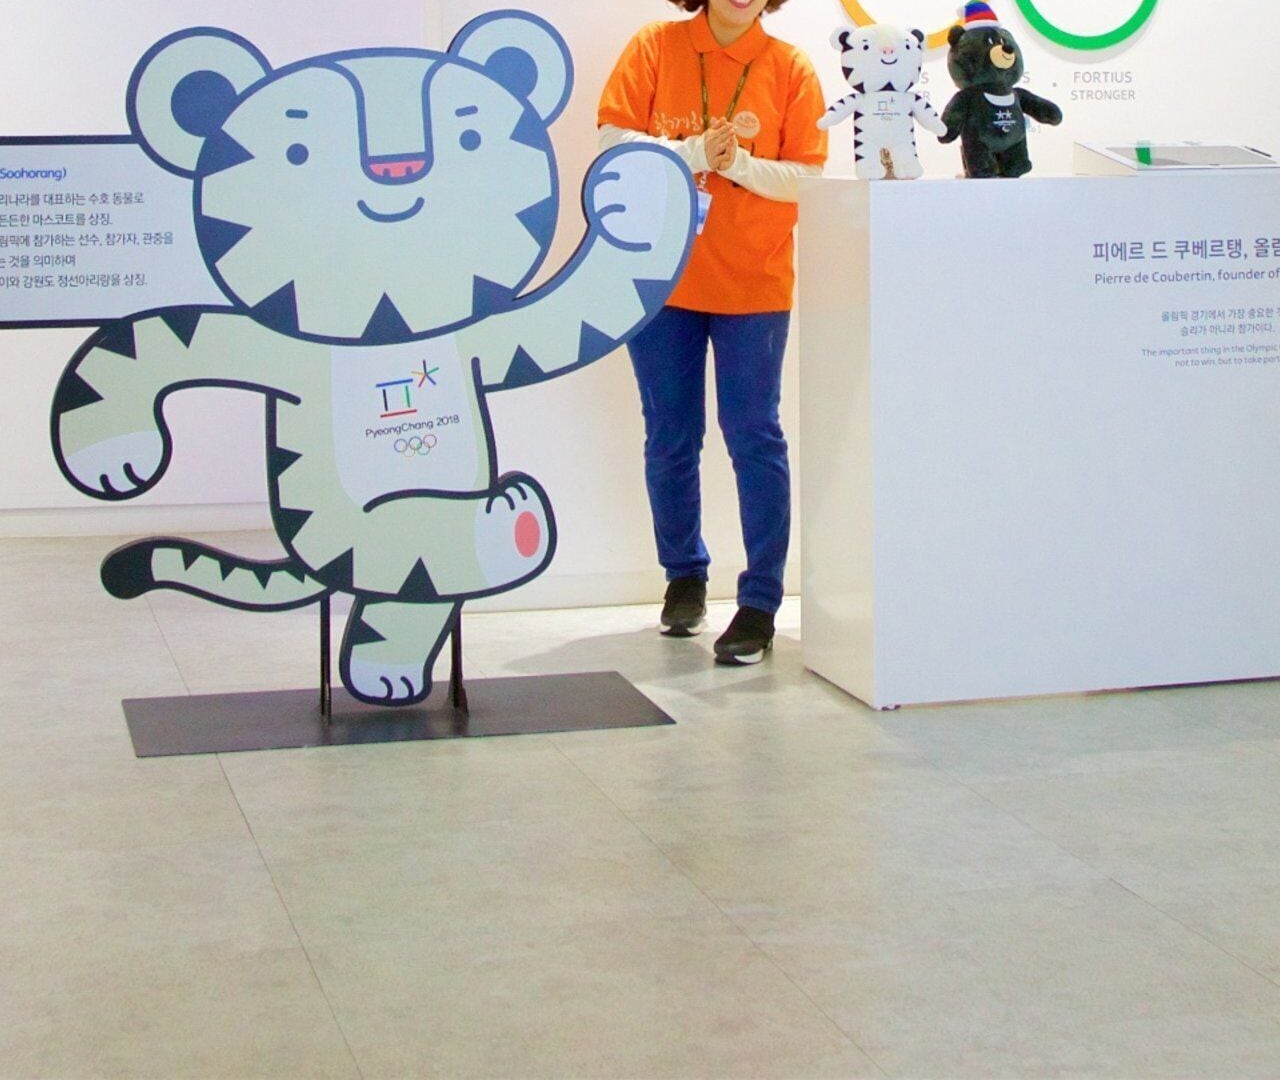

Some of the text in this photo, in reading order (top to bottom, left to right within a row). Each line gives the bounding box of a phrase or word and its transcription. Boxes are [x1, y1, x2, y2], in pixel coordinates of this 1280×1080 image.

[1073, 71, 1132, 83] FORTIUS
[1070, 90, 1136, 101] STRONGER
[43, 193, 86, 207] 대표하는
[88, 192, 110, 205] 수호
[112, 192, 144, 205] 동물로
[32, 213, 86, 227] 마스코트를
[88, 212, 113, 226] 상징.
[33, 234, 76, 247] 참가하는
[78, 233, 103, 247] 선수,
[105, 232, 140, 246] 참가자,
[142, 232, 175, 245] 관중을
[1093, 241, 1146, 262] 피에르
[1151, 241, 1168, 260] 드
[1174, 238, 1248, 261] 쿠베르탱,
[8, 255, 31, 268] 것을
[33, 254, 76, 267] 의미하며
[23, 275, 55, 288] 강원도
[57, 273, 121, 287] 정선아리랑을
[123, 272, 148, 286] 상징.
[1094, 272, 1131, 284] Pierre
[1133, 271, 1149, 283] de
[1152, 269, 1215, 283] Coubertin,
[1217, 267, 1266, 281] founder
[1268, 267, 1280, 279] of
[1141, 348, 1157, 357] The
[1158, 347, 1199, 357] important
[1200, 346, 1222, 356] thing
[1222, 346, 1230, 354] in
[1231, 345, 1245, 353] the
[1245, 344, 1277, 354] Olympic
[365, 414, 460, 439] PyeongChang 2018
